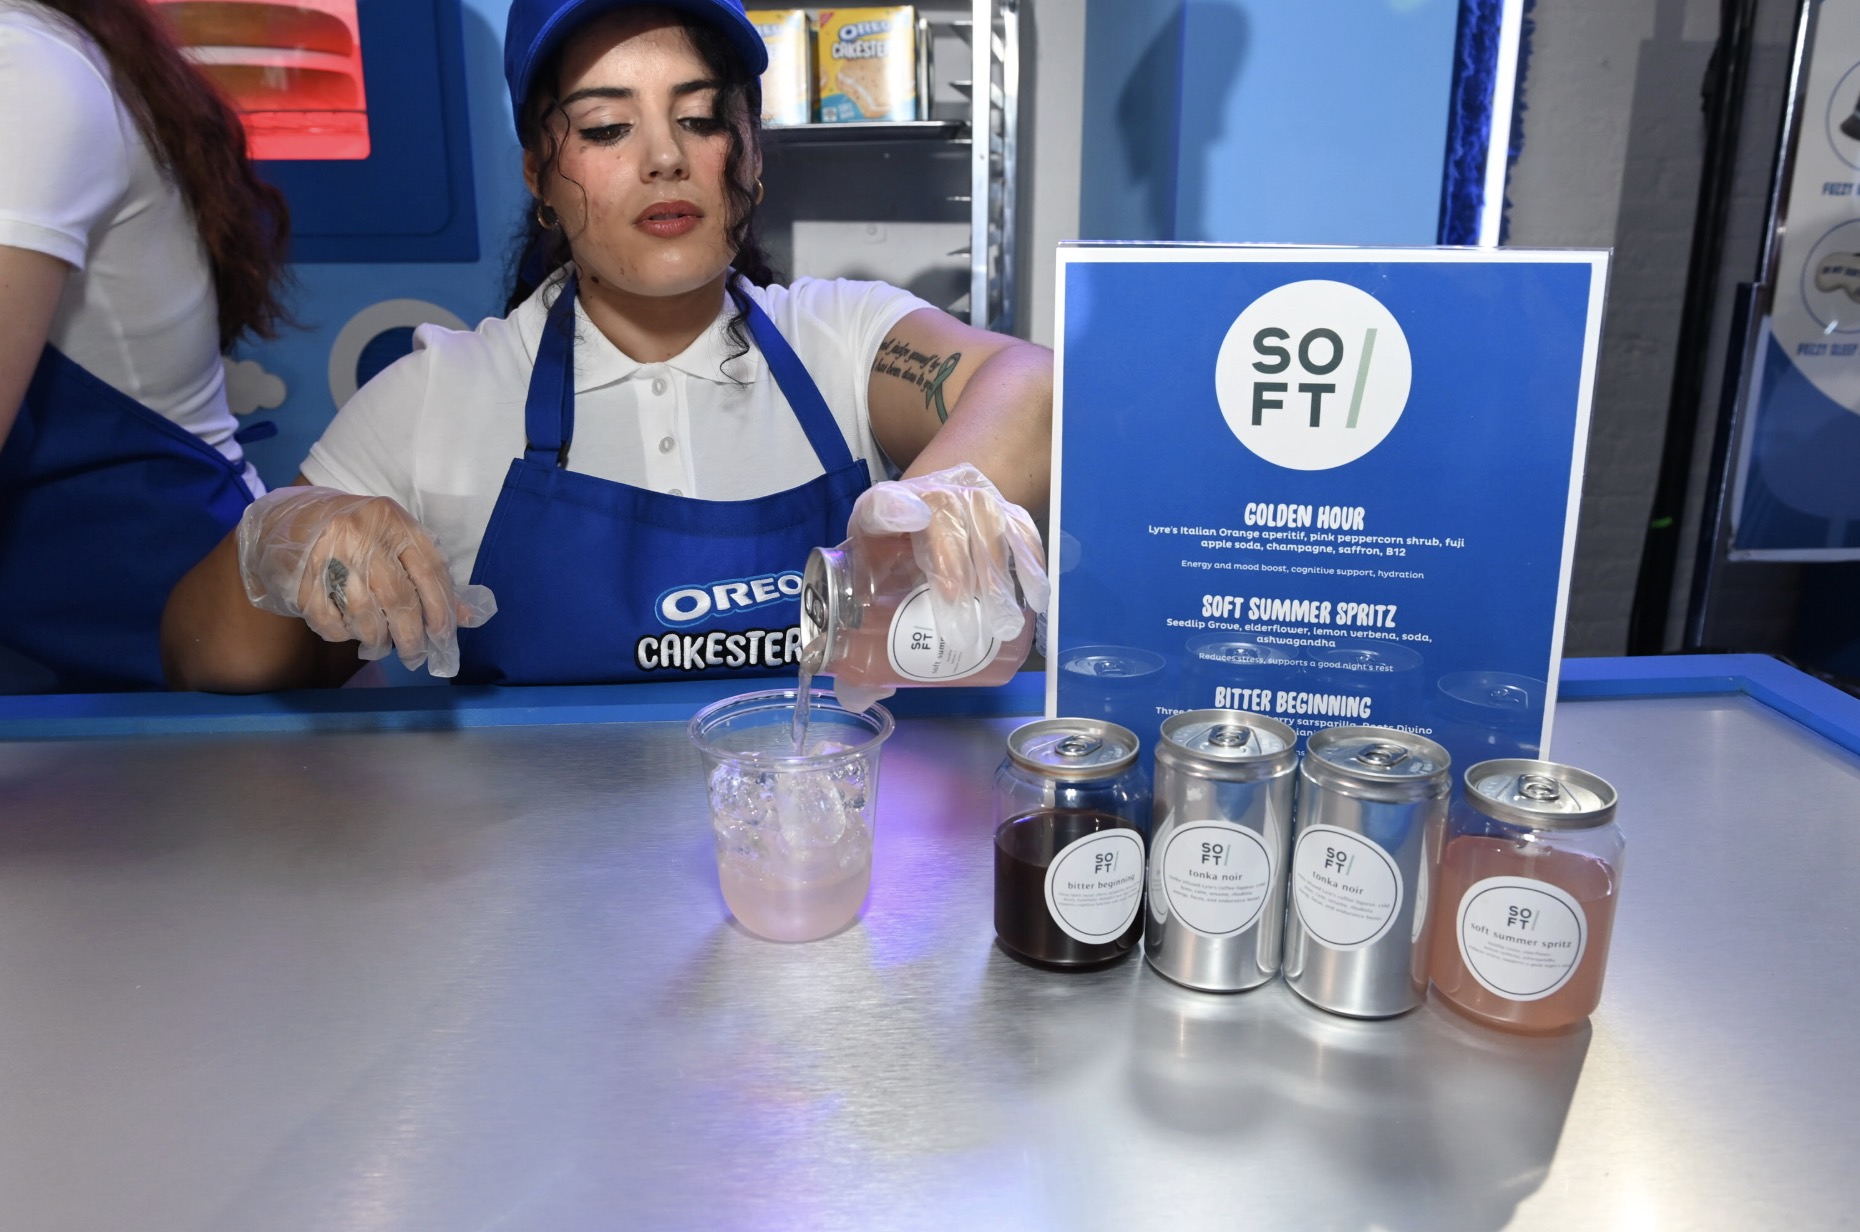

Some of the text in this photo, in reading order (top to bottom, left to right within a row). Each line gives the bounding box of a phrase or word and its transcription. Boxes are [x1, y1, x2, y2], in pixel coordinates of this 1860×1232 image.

[832, 40, 891, 59] CAKESTE
[1251, 327, 1344, 375] SO
[1251, 382, 1336, 427] FT
[1244, 502, 1365, 531] GOLDEN HOUR
[1148, 525, 1465, 549] Lyre's Italian Orange aperitif, pink peppercorn shrub, fuji
[1201, 539, 1406, 556] apple soda, champagne, saffron, B12
[1181, 560, 1425, 580] Energy and mood boost, cognitive support, hydration
[661, 574, 803, 621] OREO
[1202, 594, 1398, 628] SOFT SUMMER SPRITZ
[1166, 618, 1433, 643] Seedlip Grove, elderflower, lemon verbena, soda,
[637, 627, 803, 670] CAKESTER
[911, 632, 923, 650] SO
[922, 633, 933, 650] FT
[1256, 635, 1336, 647] ashwagandha
[1199, 652, 1236, 662] Reduces
[1238, 656, 1267, 665] stress,
[1268, 657, 1308, 667] supports
[1318, 660, 1341, 670] good
[1342, 661, 1374, 672] night's
[1375, 664, 1394, 672] rest
[1155, 706, 1185, 715] Three
[1214, 686, 1372, 719] BITTER BEGINNING
[1201, 842, 1224, 855] SO
[1326, 847, 1347, 863] SO
[1095, 852, 1114, 864] SO
[1201, 854, 1222, 866] FT
[1324, 859, 1345, 873] FT
[1095, 863, 1112, 874] FT
[1189, 869, 1243, 881] tonka noir
[1067, 874, 1136, 890] bitter beginning
[1312, 870, 1364, 895] tonka noir
[1508, 905, 1532, 919] SO
[1507, 917, 1530, 930] FT
[1470, 922, 1572, 950] soft summer spritz
